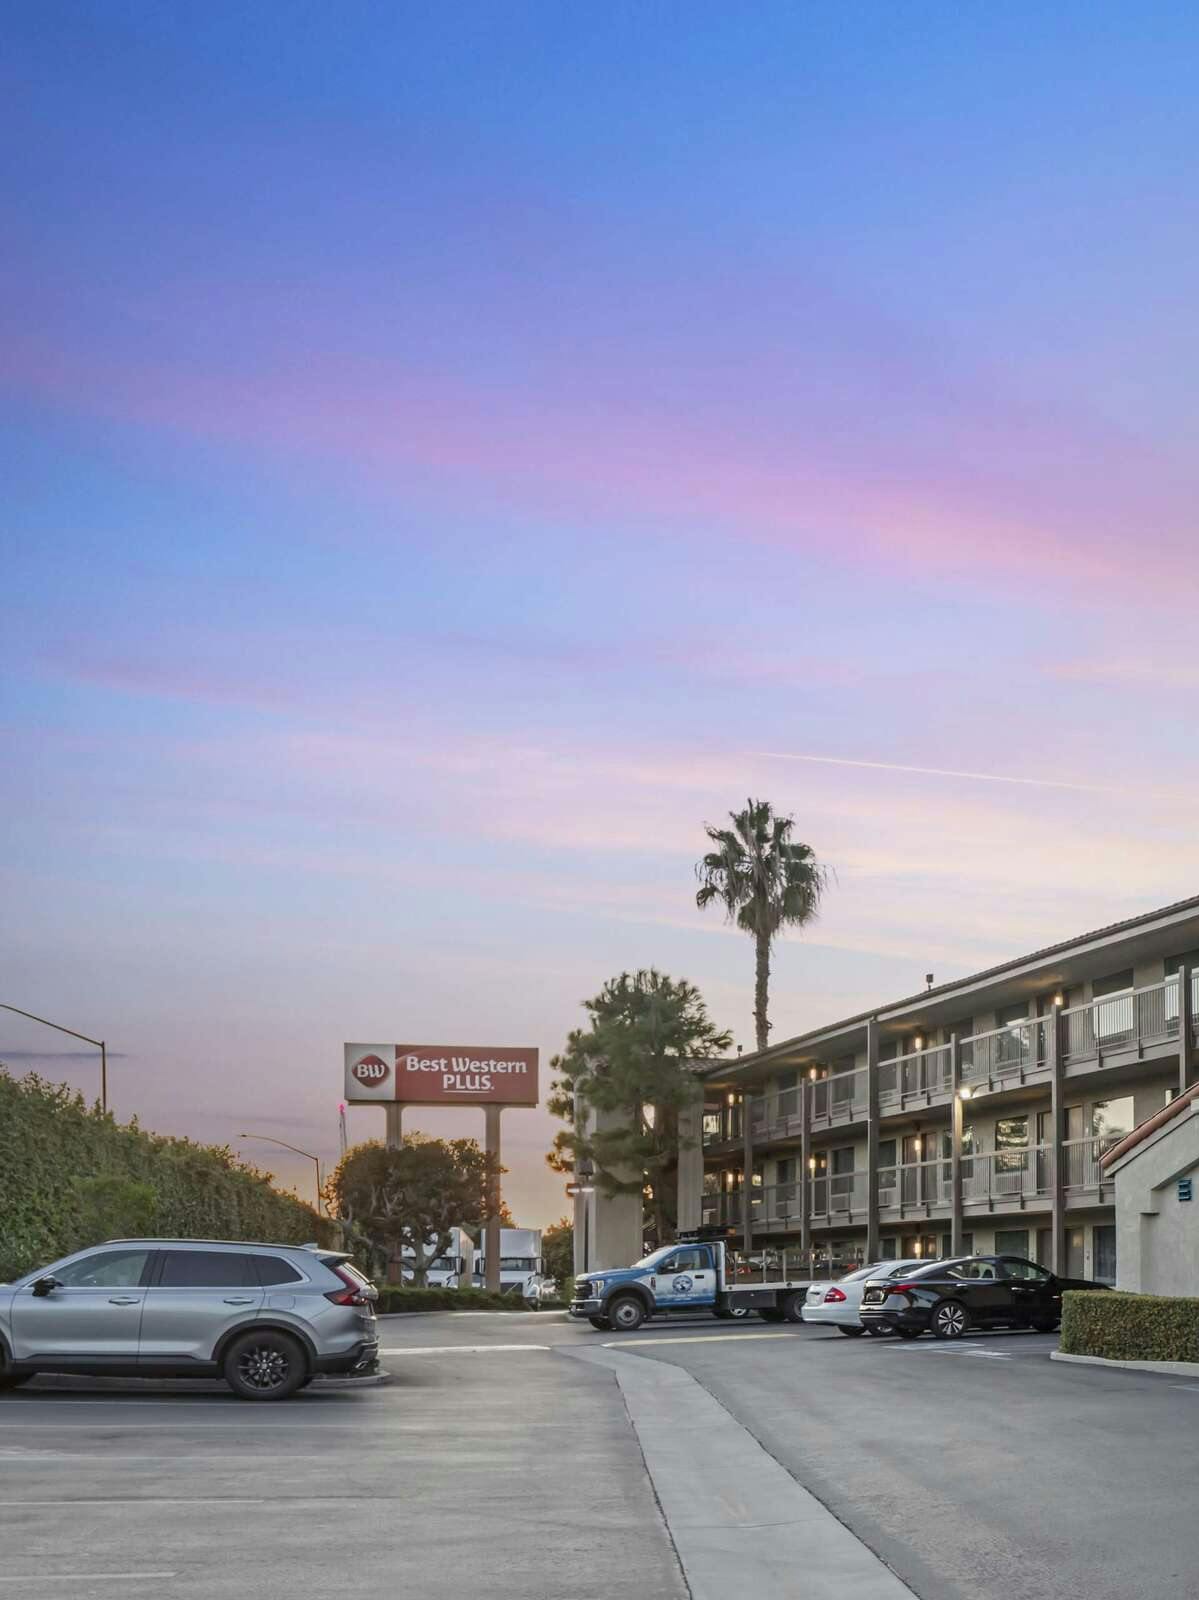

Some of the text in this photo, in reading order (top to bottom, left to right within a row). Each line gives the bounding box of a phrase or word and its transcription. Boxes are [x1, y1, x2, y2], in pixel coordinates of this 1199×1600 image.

[357, 1064, 385, 1078] BW
[406, 1056, 527, 1073] Best Western
